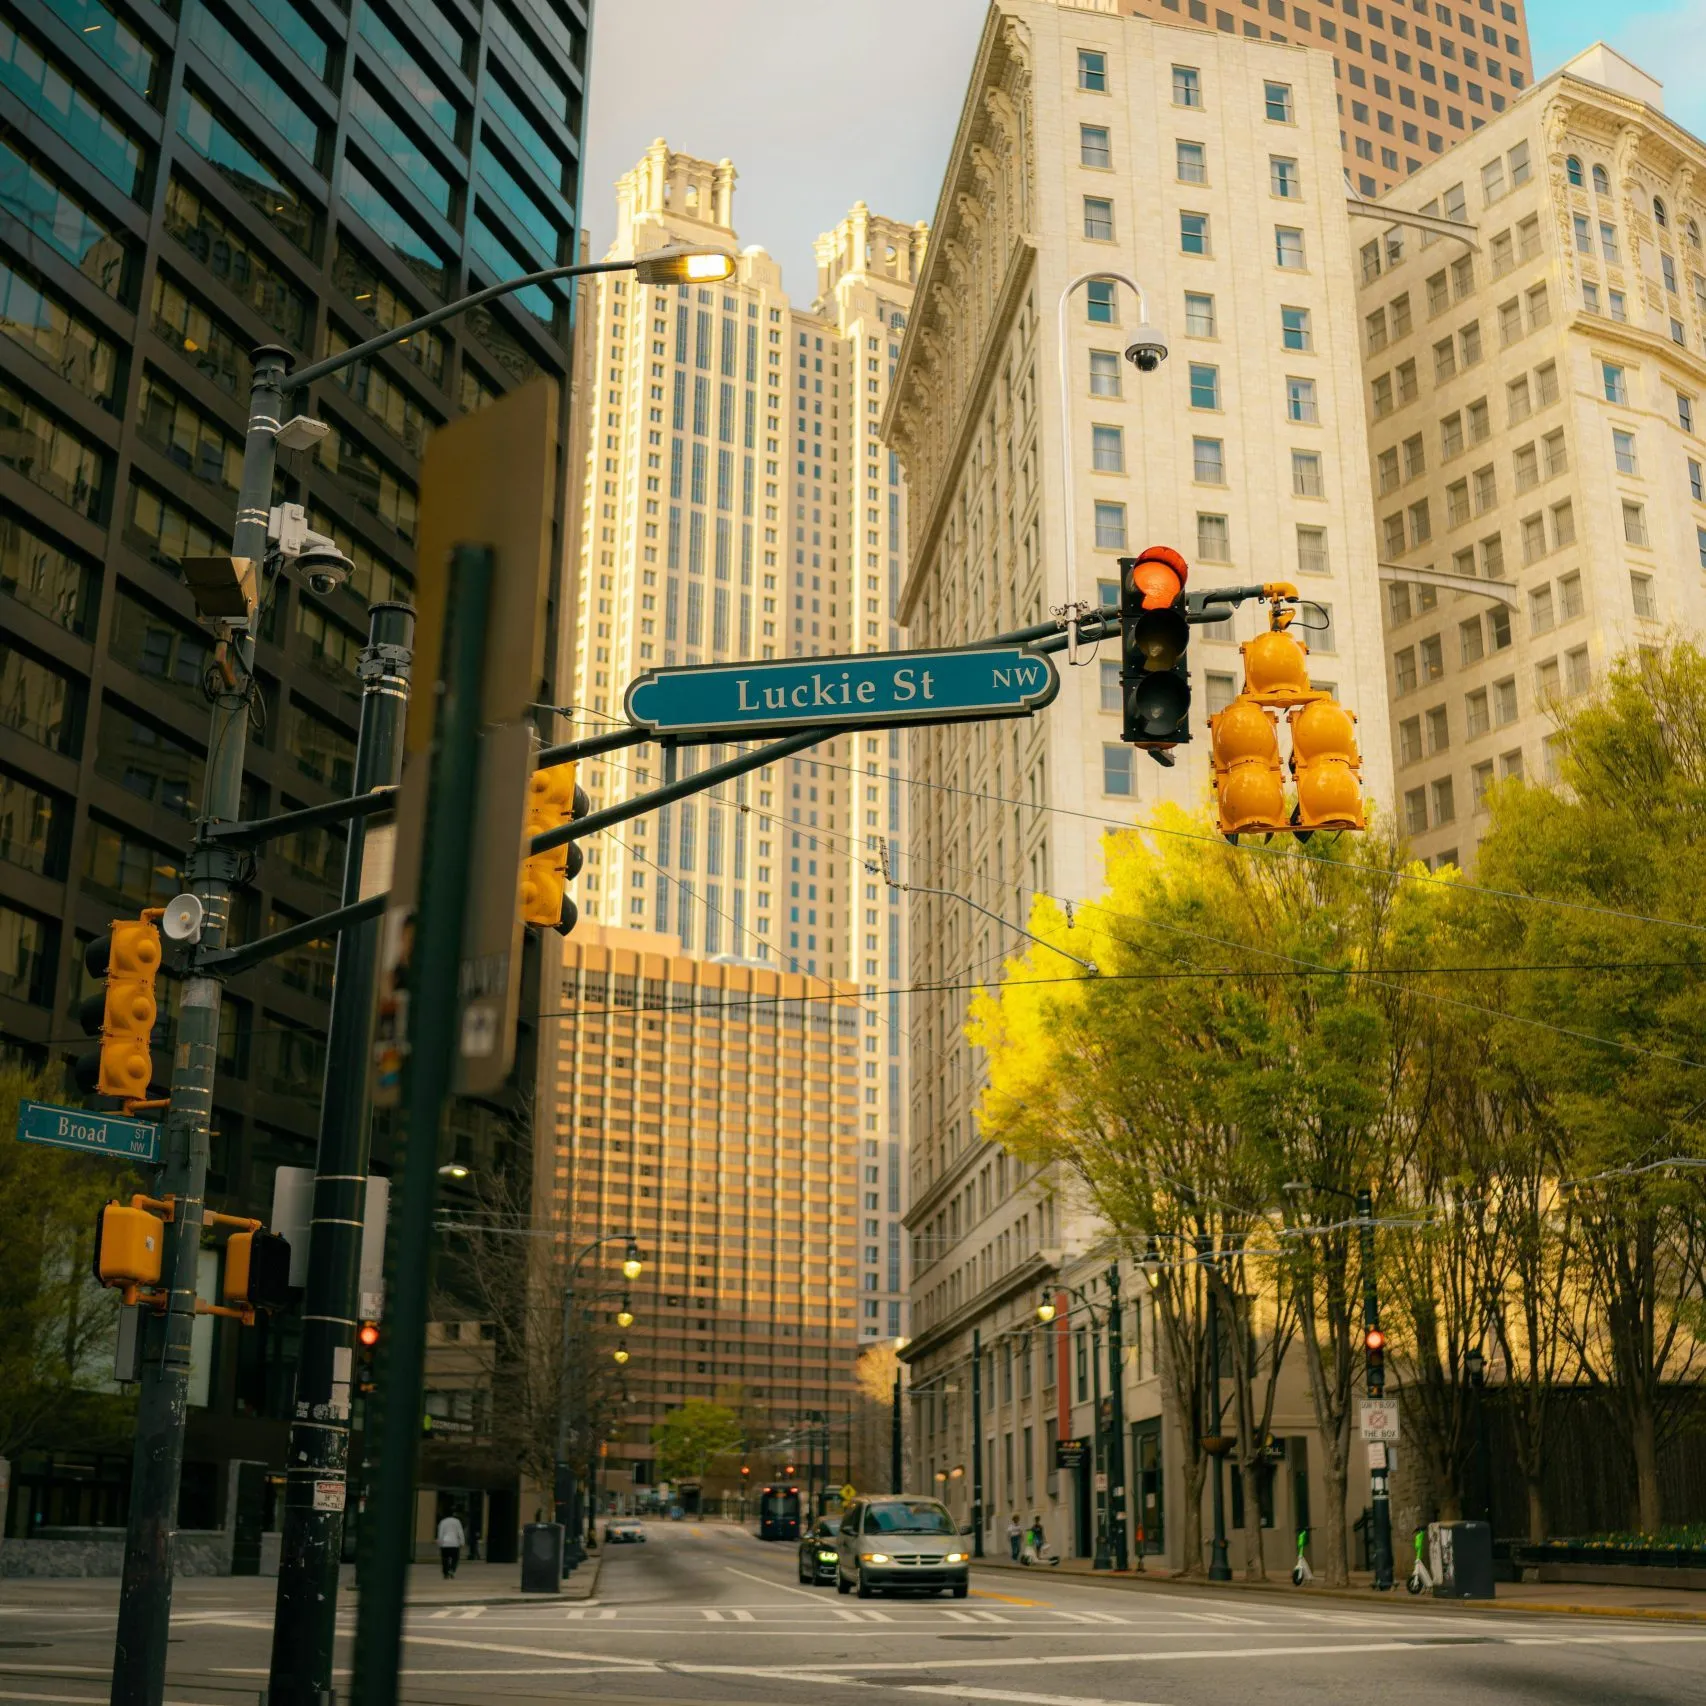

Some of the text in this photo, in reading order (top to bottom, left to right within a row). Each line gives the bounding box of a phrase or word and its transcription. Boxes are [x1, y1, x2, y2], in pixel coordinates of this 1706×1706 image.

[736, 667, 1039, 710] Luckie St NW
[58, 1116, 107, 1143] Broad
[135, 1128, 146, 1139] ST
[130, 1141, 145, 1153] NW
[1364, 1430, 1395, 1438] THE BOX
